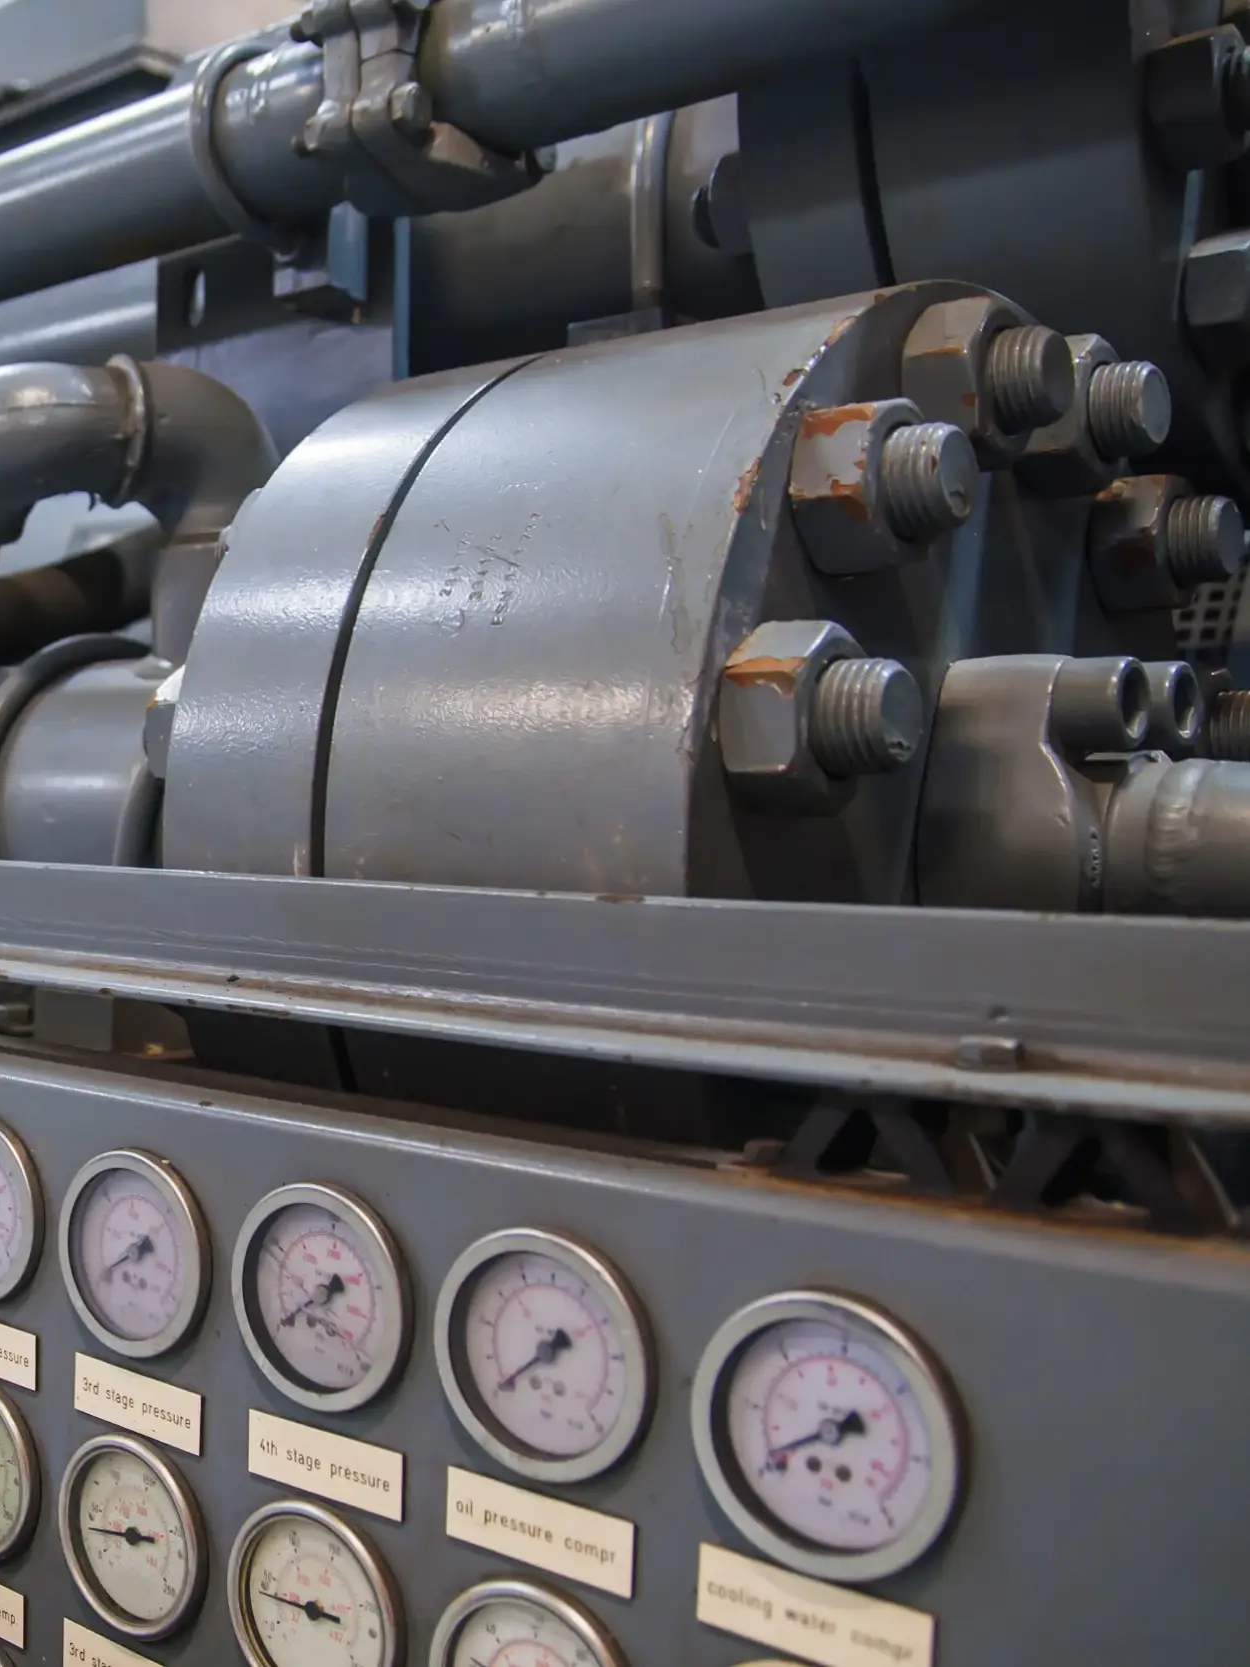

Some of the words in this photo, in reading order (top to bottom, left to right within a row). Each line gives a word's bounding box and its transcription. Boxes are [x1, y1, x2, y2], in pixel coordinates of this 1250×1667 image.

[82, 1377, 99, 1395] 3rd
[105, 1387, 135, 1410] stage
[141, 1402, 191, 1429] pressure
[259, 1437, 278, 1456] 4th
[286, 1446, 321, 1472] stage
[330, 1463, 390, 1492] pressure
[456, 1499, 474, 1518] oil
[483, 1507, 553, 1542] pressure
[564, 1535, 616, 1565] compr
[707, 1581, 773, 1619] cooling
[785, 1606, 837, 1634] water
[69, 1642, 86, 1661] 3rd
